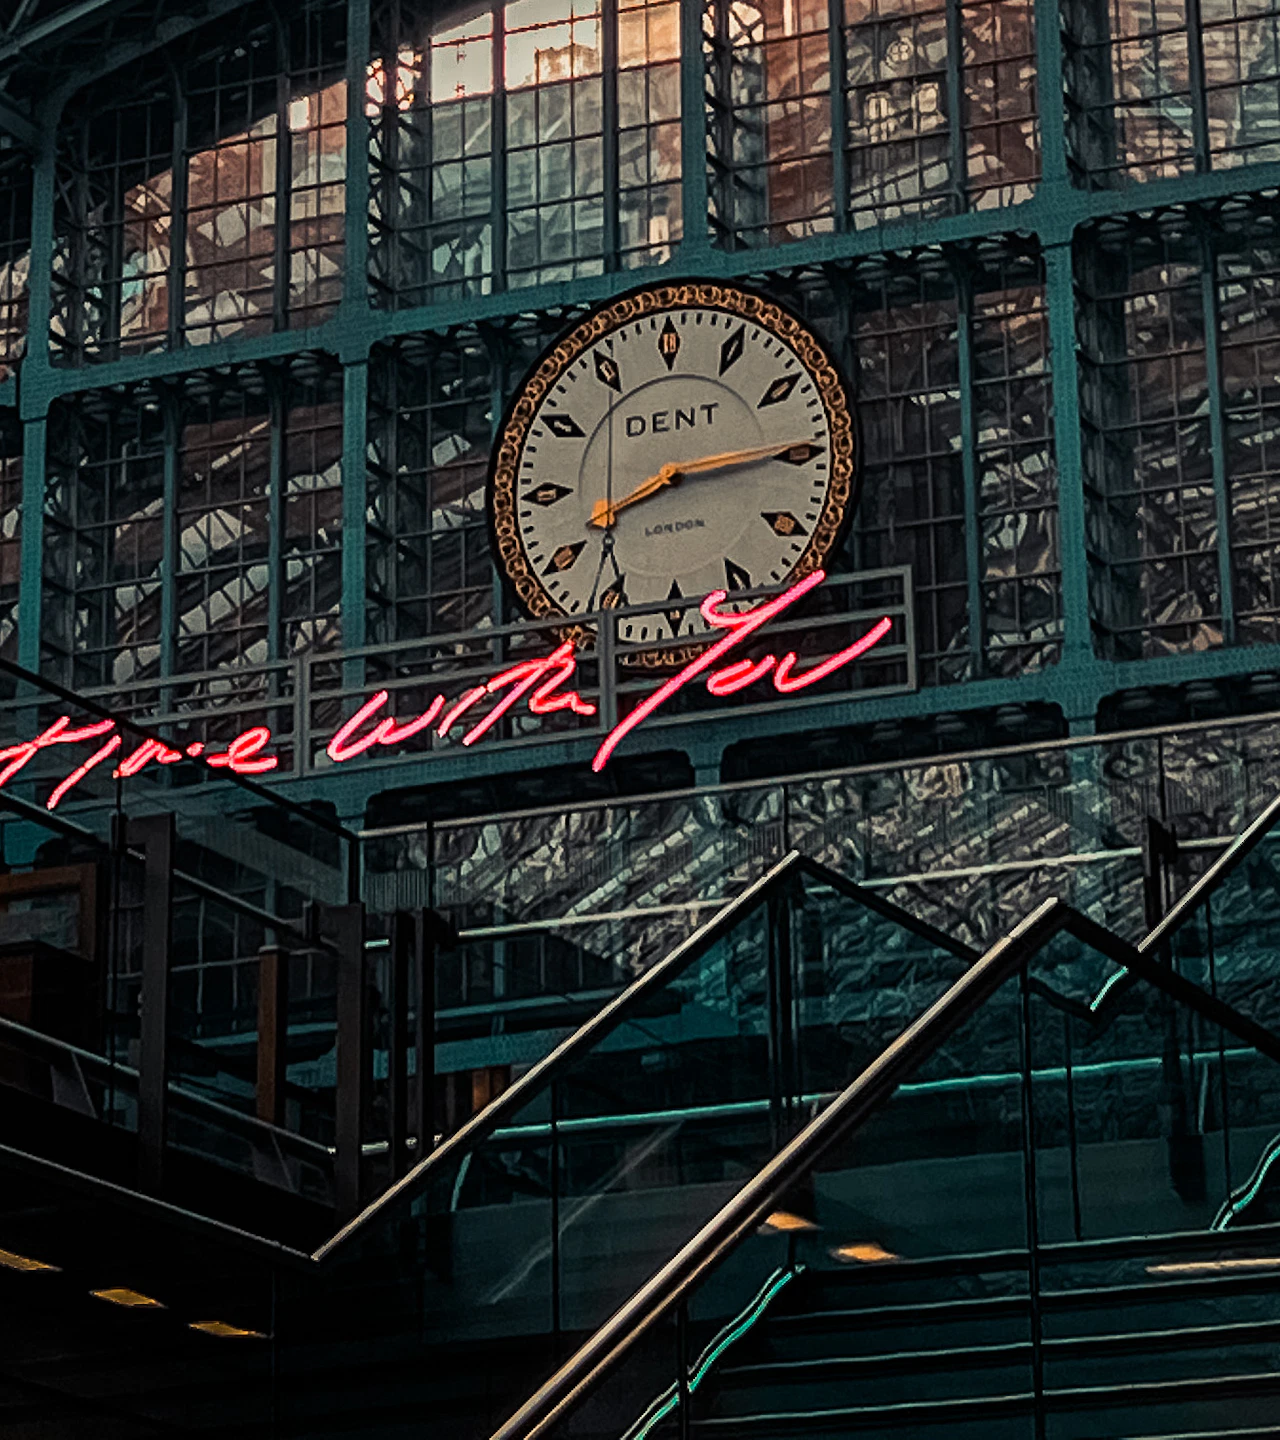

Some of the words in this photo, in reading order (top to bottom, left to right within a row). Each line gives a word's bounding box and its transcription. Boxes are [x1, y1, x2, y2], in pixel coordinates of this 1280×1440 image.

[625, 402, 720, 438] DENT
[644, 519, 705, 537] LONDON
[325, 639, 597, 763] with
